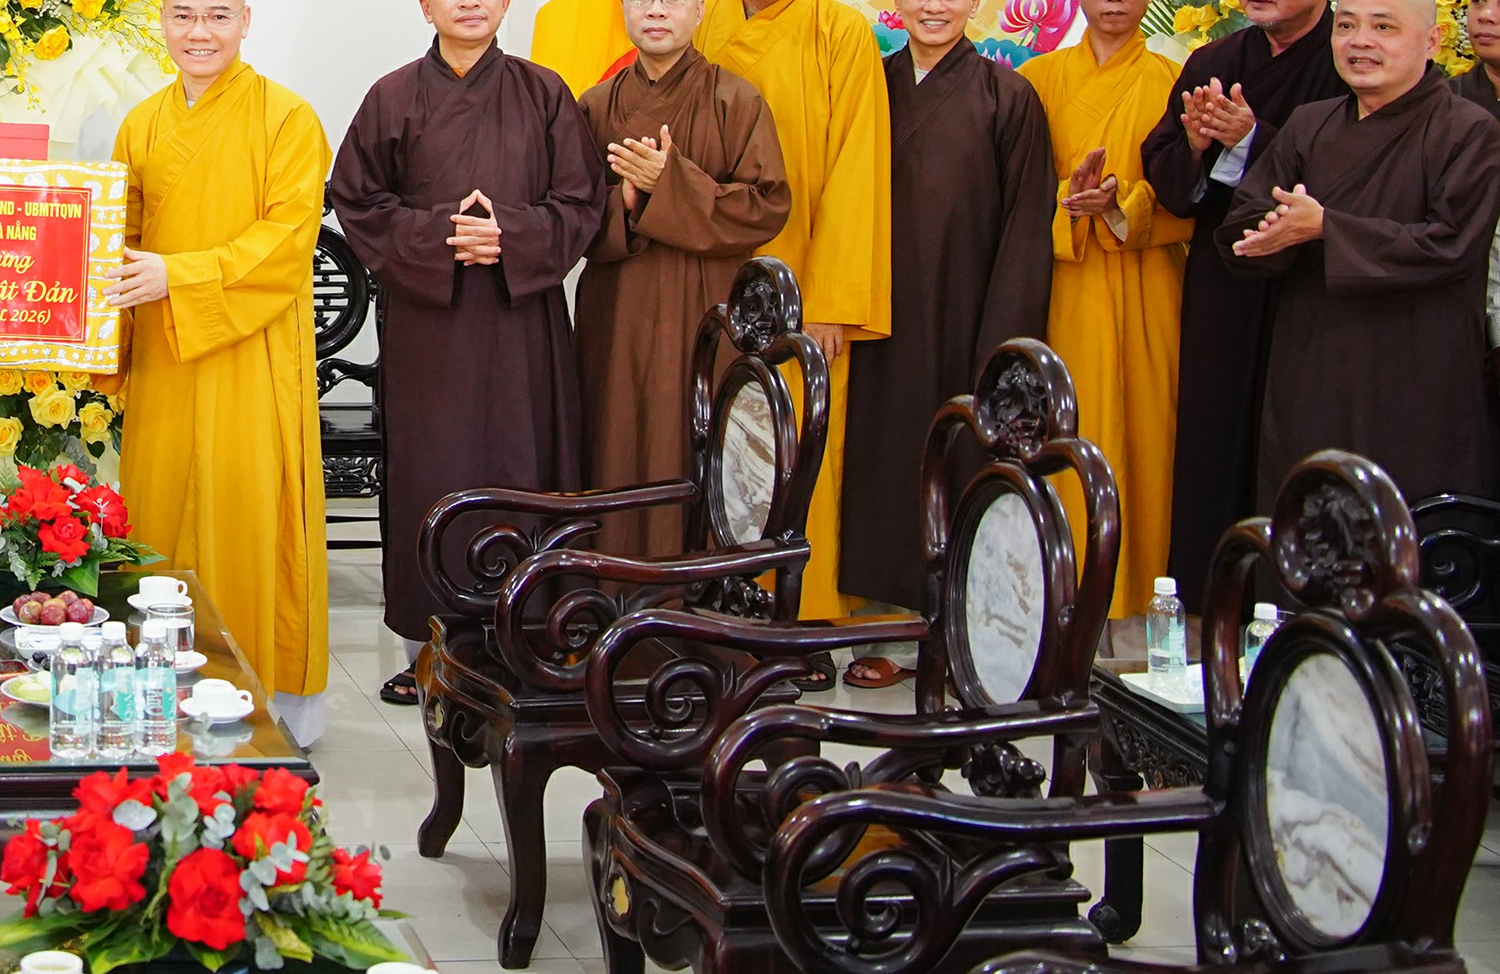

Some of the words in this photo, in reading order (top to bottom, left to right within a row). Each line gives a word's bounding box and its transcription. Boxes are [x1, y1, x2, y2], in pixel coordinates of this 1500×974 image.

[25, 202, 82, 219] UBMTTQVN
[23, 280, 78, 304] Đản
[10, 309, 51, 324] 2026)
